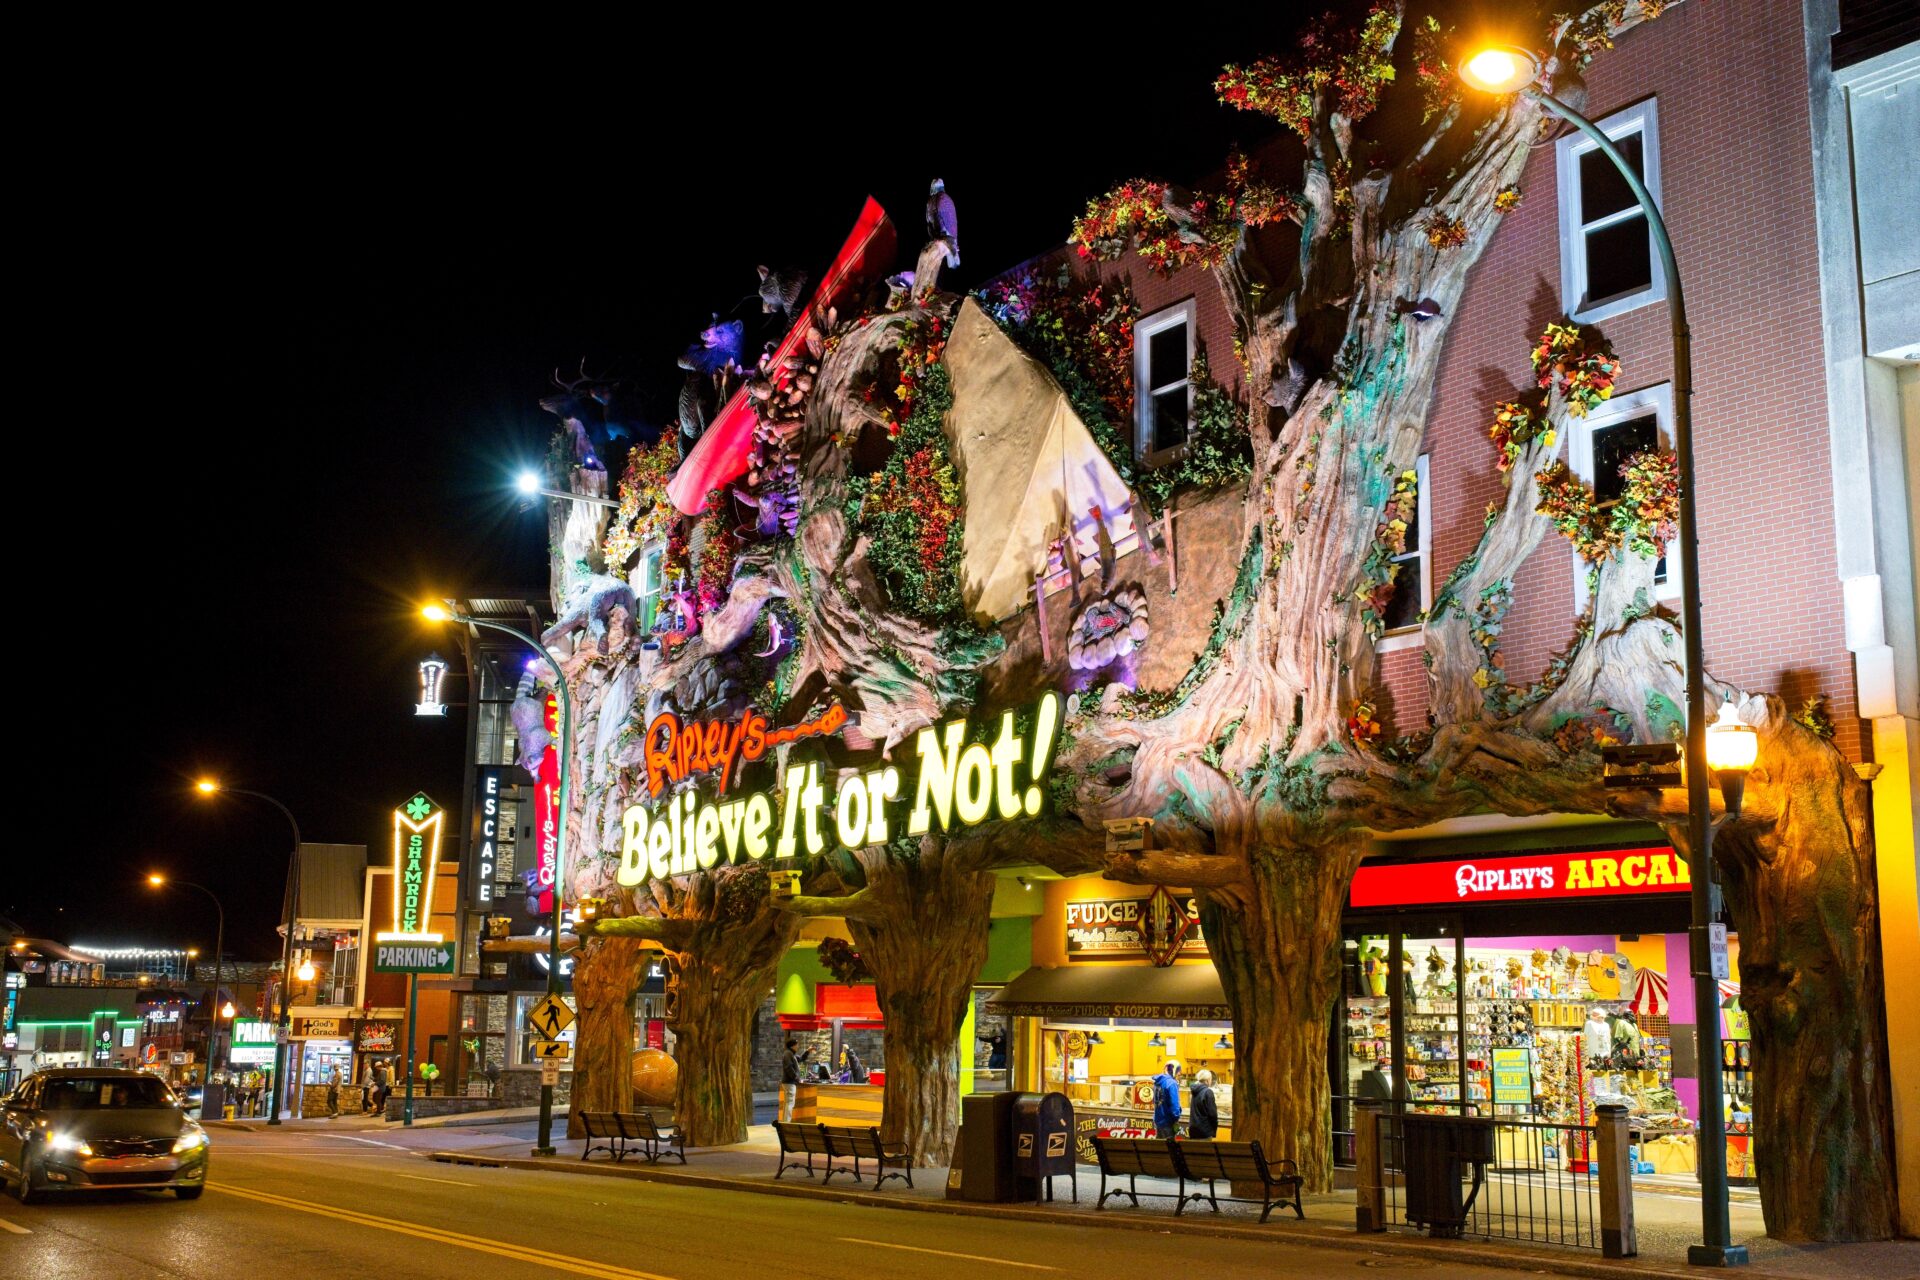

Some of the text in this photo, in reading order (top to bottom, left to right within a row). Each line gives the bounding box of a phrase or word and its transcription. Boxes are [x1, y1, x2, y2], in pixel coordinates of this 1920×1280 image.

[644, 709, 767, 798] Ripley's
[617, 691, 1059, 887] Believe It or Not!
[480, 777, 497, 902] ESCAPE
[403, 834, 423, 933] SHAMROCK
[1455, 854, 1691, 897] RIPLEY'S ARCA
[1067, 902, 1138, 925] FUDGE
[1714, 930, 1722, 941] NO
[377, 947, 437, 967] PARKING
[1074, 1006, 1110, 1017] FUDGE
[1112, 1006, 1160, 1018] SHOPPE
[1165, 1006, 1179, 1019] OF
[1184, 1006, 1209, 1019] THE
[235, 1022, 272, 1042] PARK
[312, 1020, 334, 1028] God's
[312, 1028, 337, 1036] Grace
[1079, 1117, 1153, 1132] THE Original Fudge
